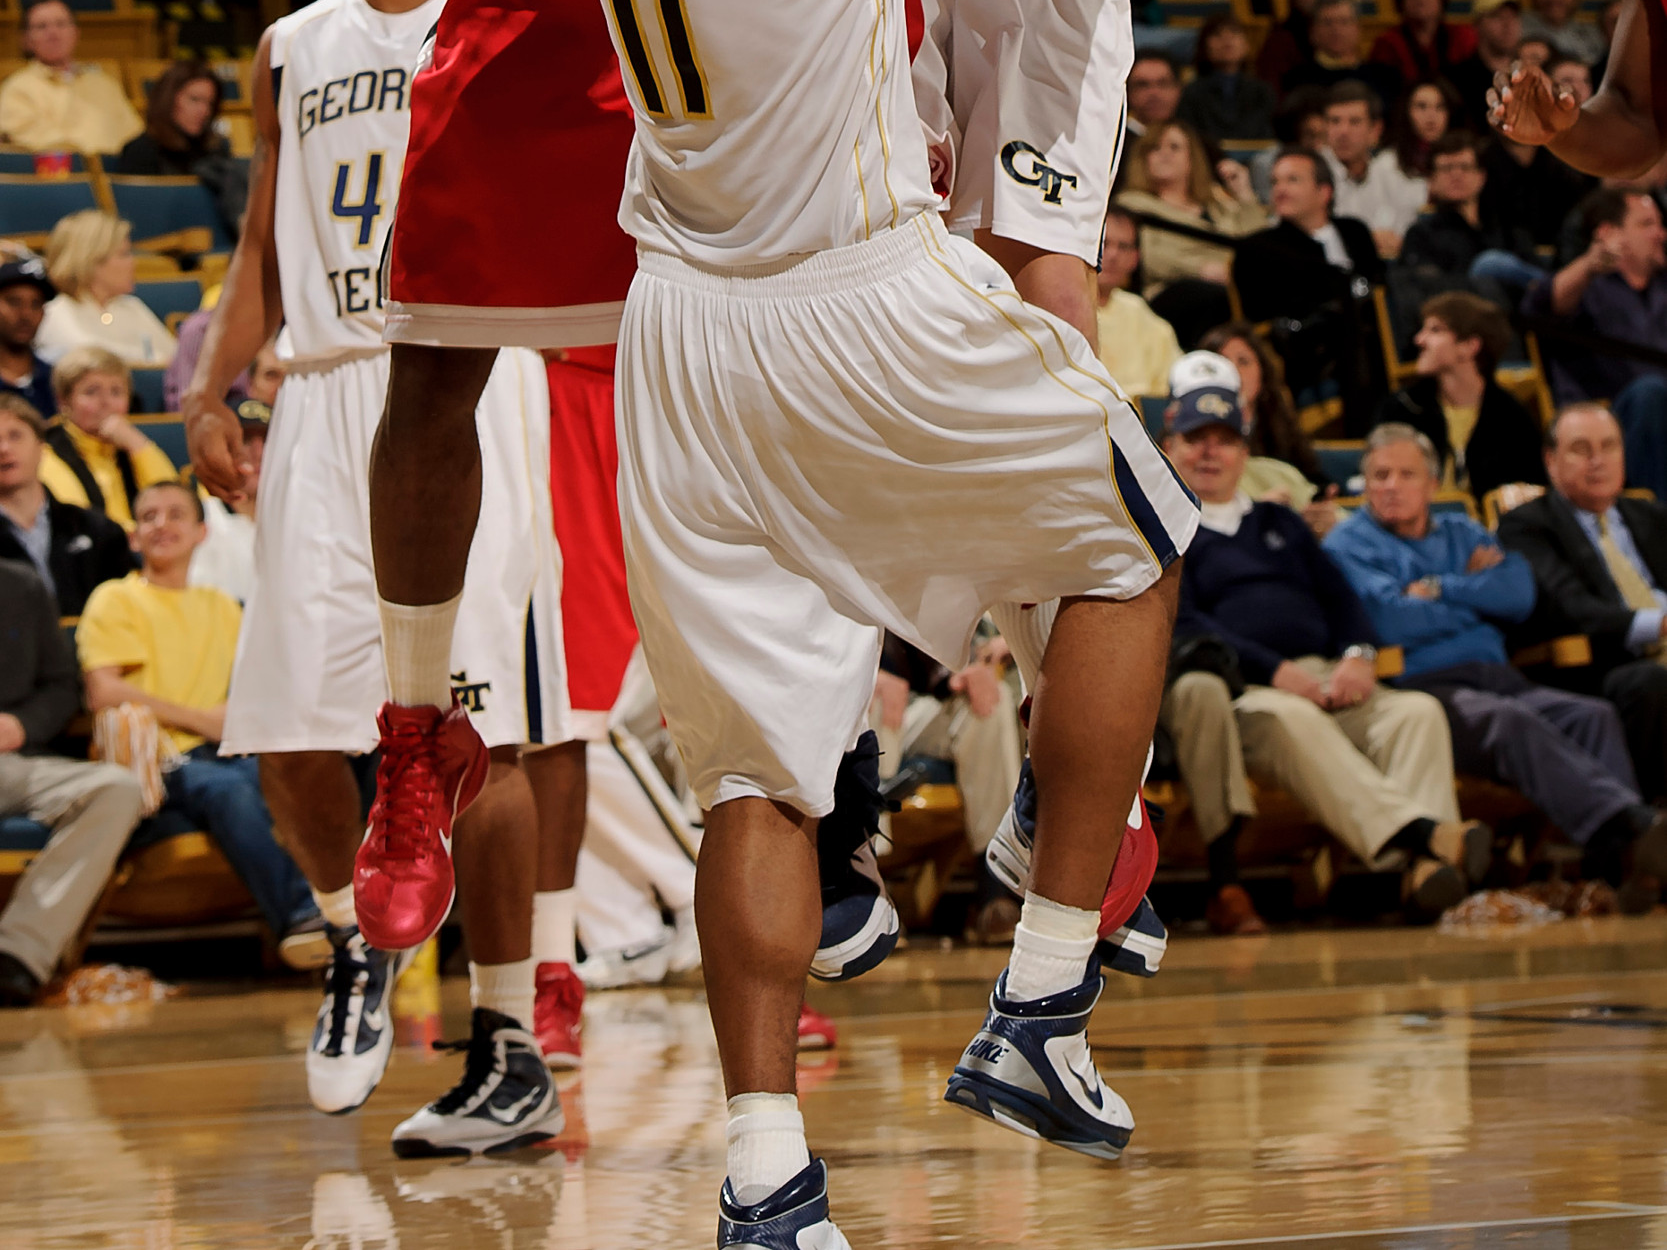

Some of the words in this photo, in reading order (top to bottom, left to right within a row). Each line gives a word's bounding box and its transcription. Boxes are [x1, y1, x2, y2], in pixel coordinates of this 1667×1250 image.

[298, 67, 411, 139] GEOR
[1000, 139, 1077, 206] GT
[328, 265, 384, 318] TE
[965, 1038, 1010, 1065] NIKE
